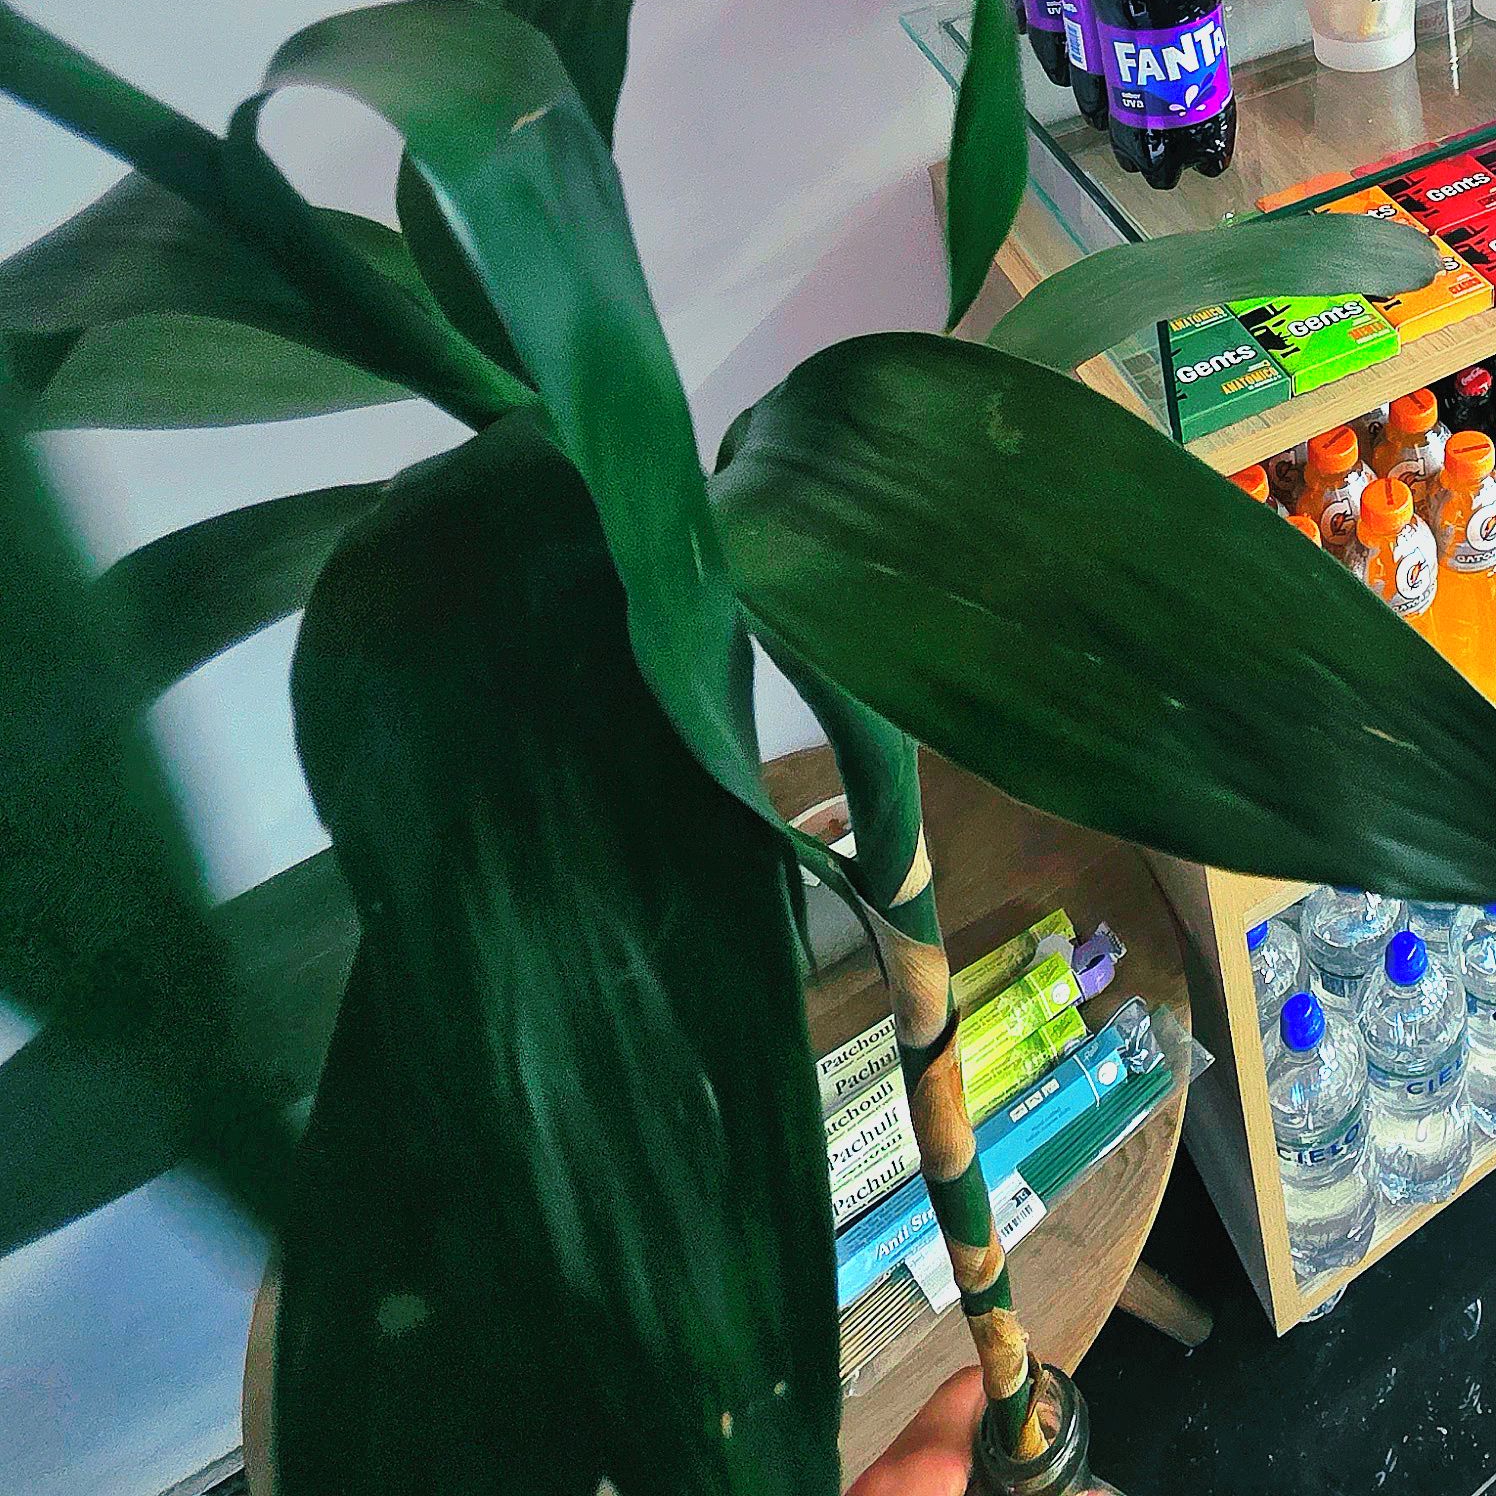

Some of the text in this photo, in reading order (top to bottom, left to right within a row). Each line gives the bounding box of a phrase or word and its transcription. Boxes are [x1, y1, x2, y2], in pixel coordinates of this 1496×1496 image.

[1113, 20, 1226, 86] FANTA
[1425, 171, 1492, 203] Gents
[1286, 300, 1366, 338] Gents
[1175, 345, 1258, 385] Gents
[821, 1019, 897, 1075] Patchoul
[835, 1044, 898, 1096] Pachul
[876, 1224, 910, 1262] Anti
